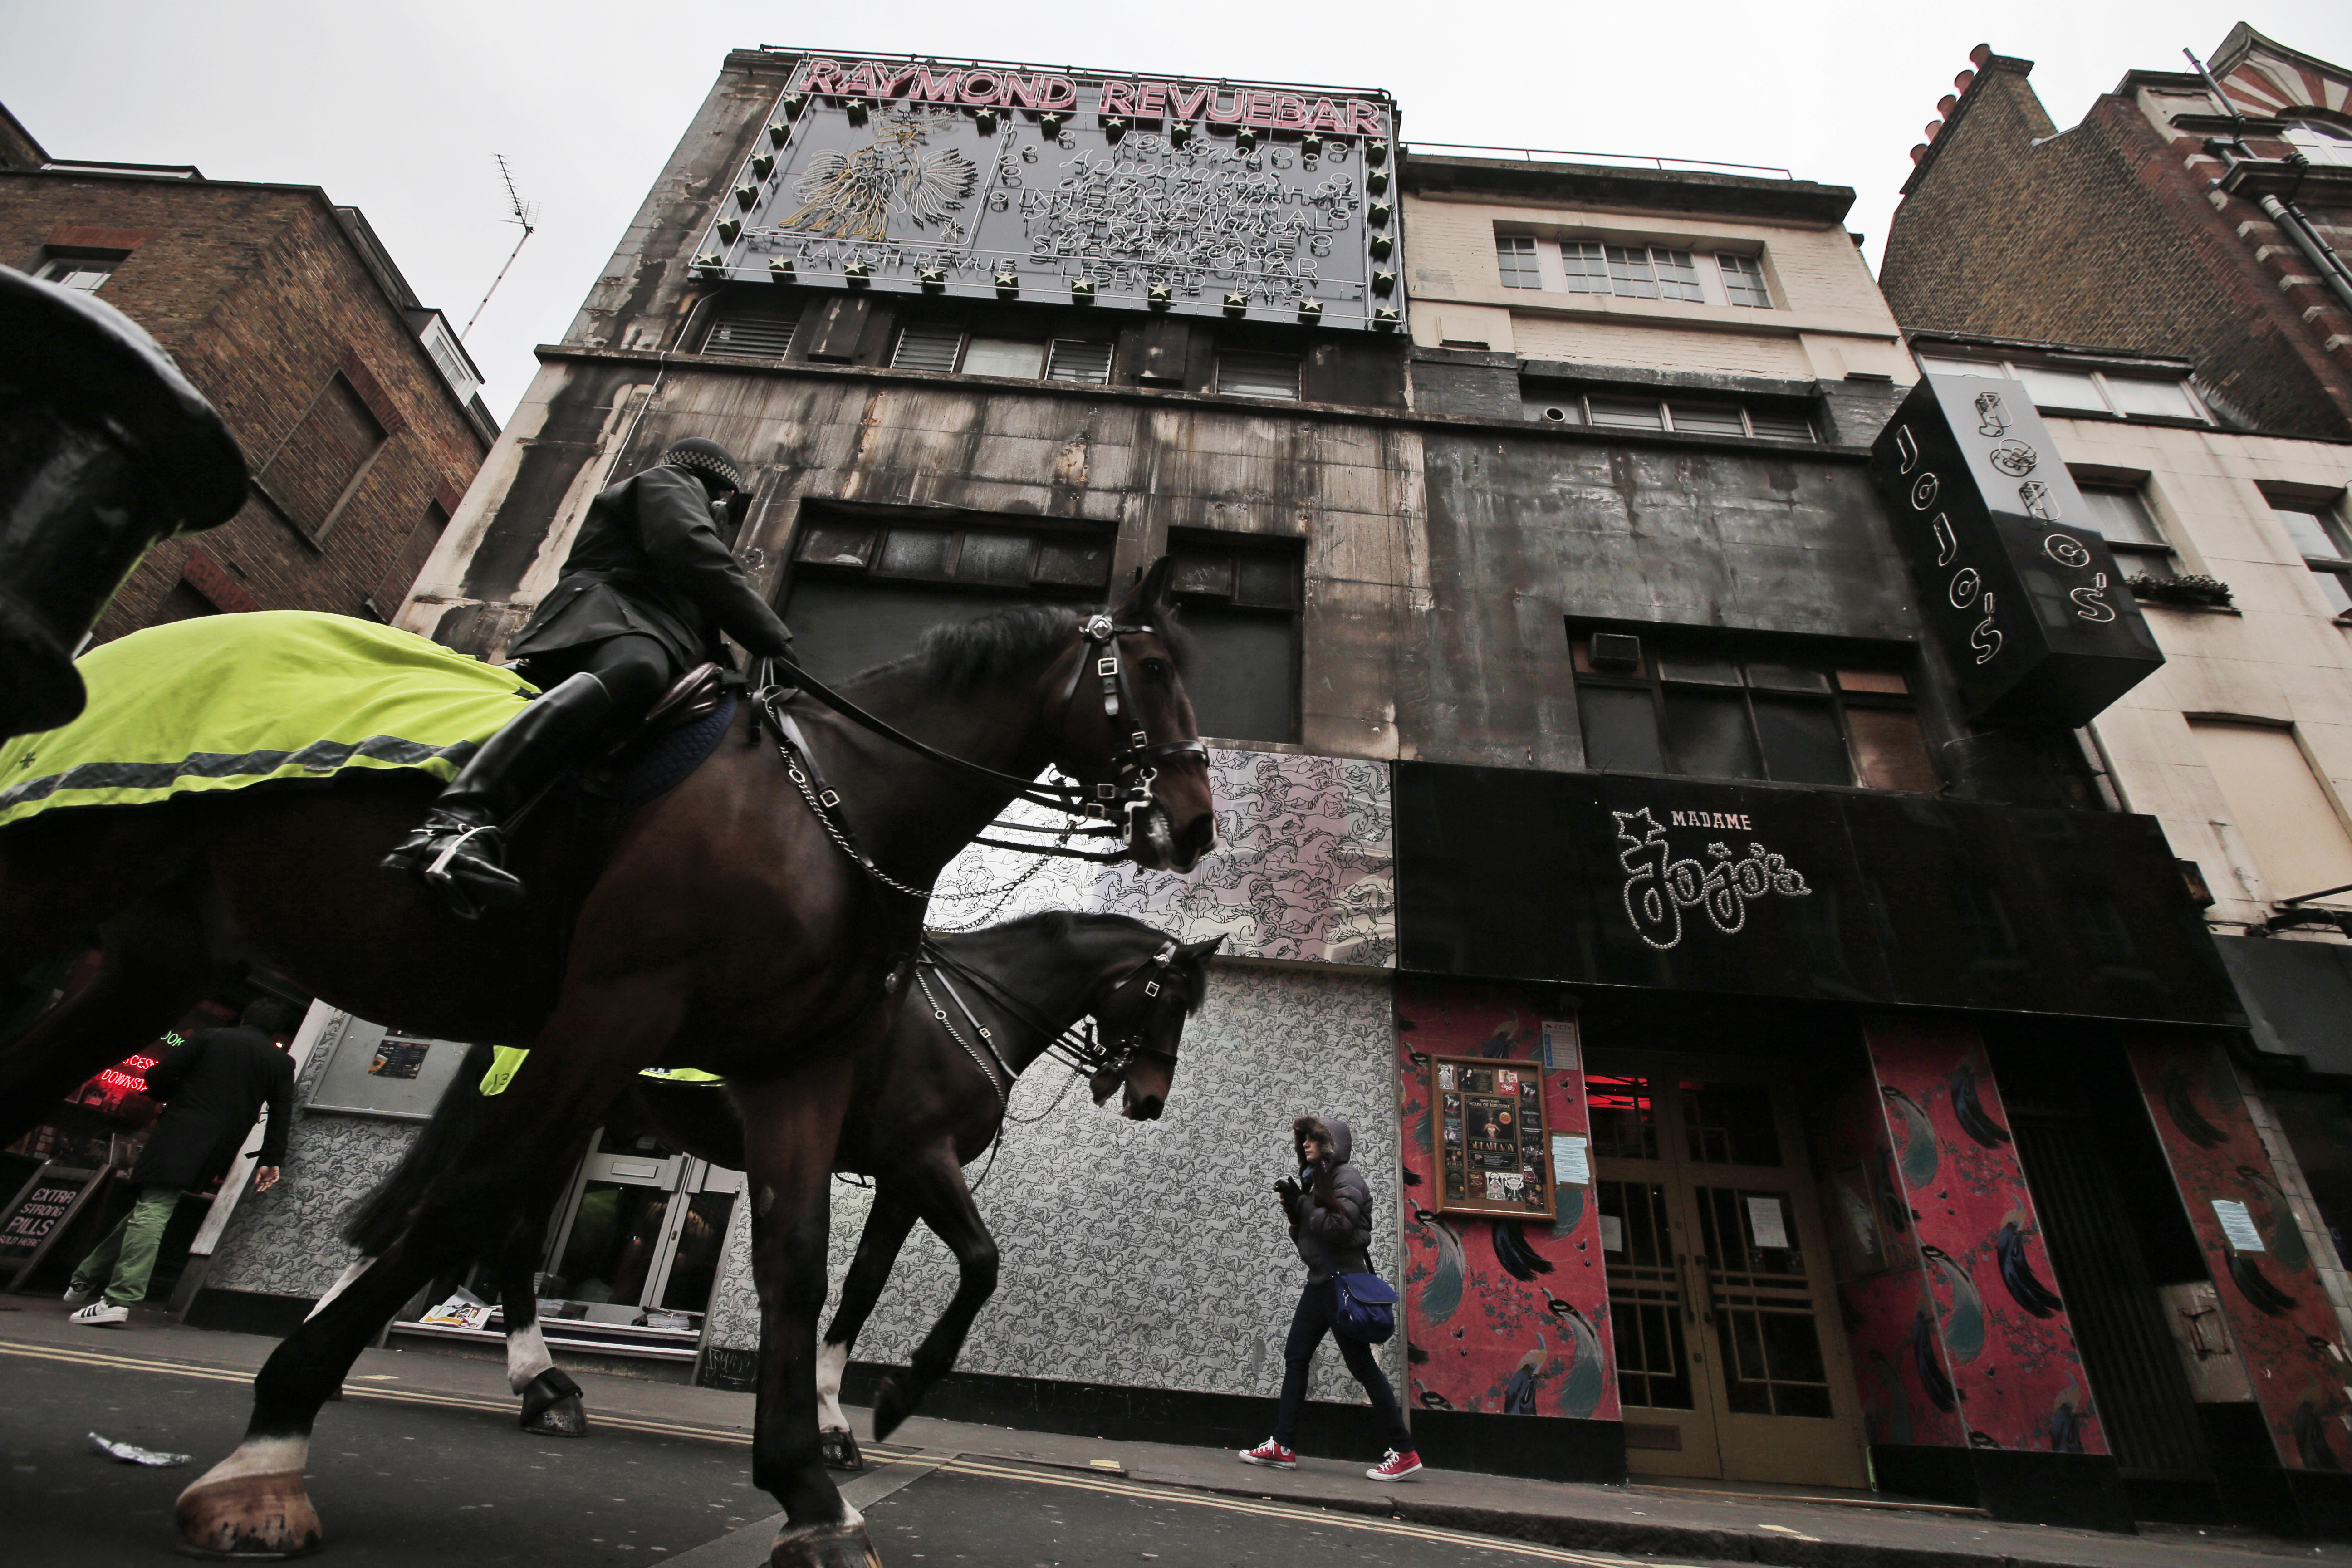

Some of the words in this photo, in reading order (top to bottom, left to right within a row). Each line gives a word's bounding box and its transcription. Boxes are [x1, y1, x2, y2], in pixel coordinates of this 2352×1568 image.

[799, 58, 1077, 108] RAYMOND
[1098, 79, 1382, 136] REVUEBAR
[1059, 148, 1281, 187] Appearances
[796, 242, 904, 268] LAVISH
[913, 251, 1016, 275] REVUE
[1061, 262, 1206, 289] LICENSED
[1235, 277, 1304, 298] BARS
[1895, 423, 2003, 665] JOJO'S
[1671, 810, 1753, 831] MADAME
[101, 1069, 148, 1091] DOWNST
[32, 1188, 77, 1204] EXTRA
[20, 1203, 65, 1217] STRONG
[5, 1216, 54, 1236] PILLS
